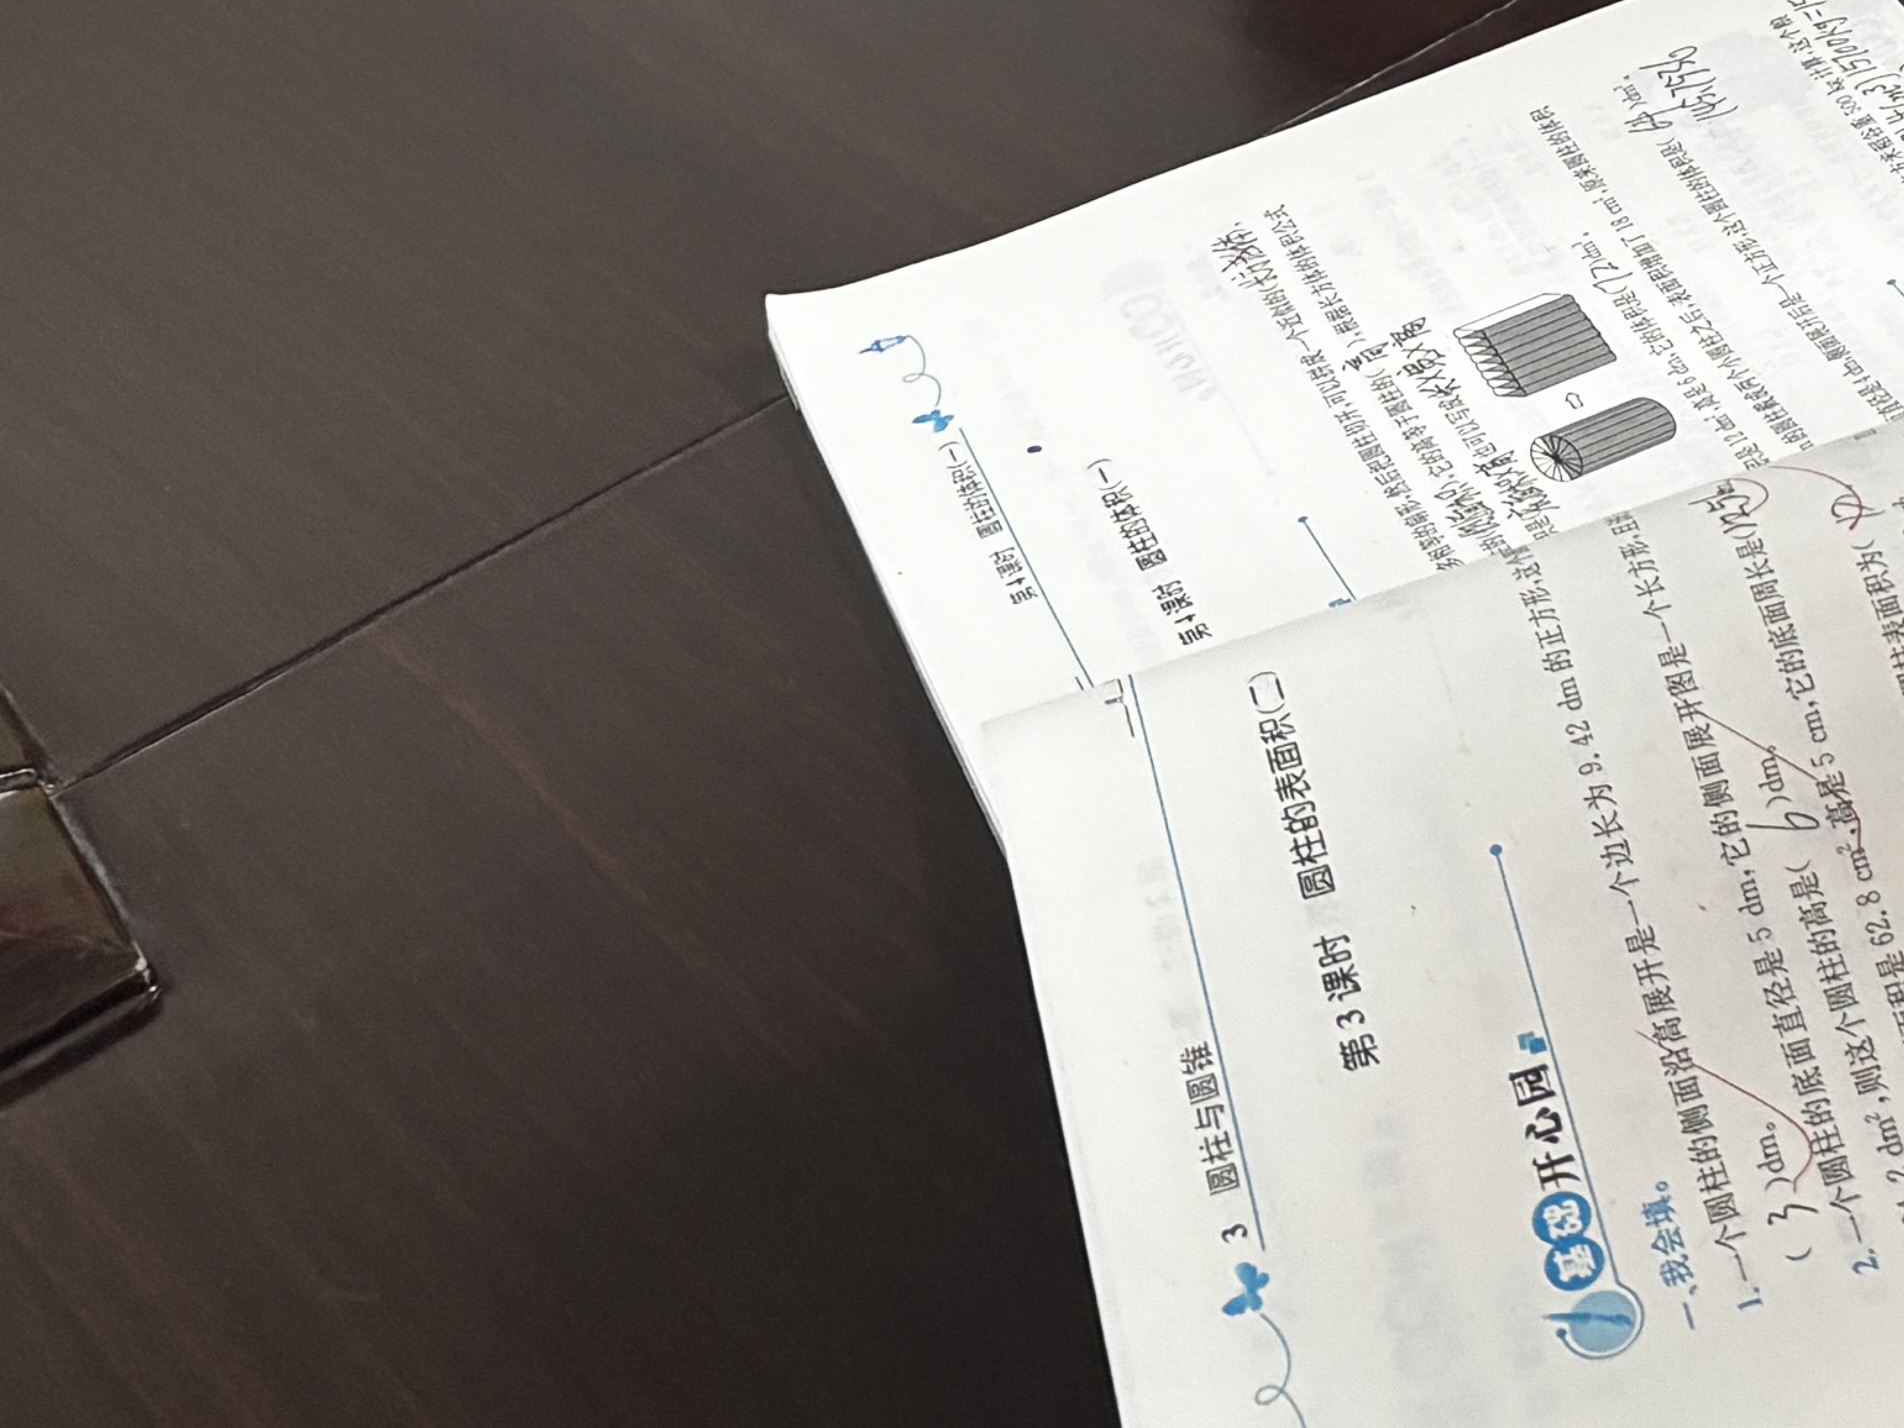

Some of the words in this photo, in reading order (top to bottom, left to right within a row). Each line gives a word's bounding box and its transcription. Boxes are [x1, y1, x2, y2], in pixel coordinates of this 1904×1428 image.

[938, 440, 1004, 539] 圆柱的体积(一)
[1086, 458, 1168, 571] 圆柱的体积(一)
[1246, 670, 1337, 900] 圆柱的表面积(二)
[1313, 933, 1381, 1072] 第3课时
[1179, 1041, 1241, 1194] 圆柱与圆锥
[1220, 1223, 1248, 1244] 3
